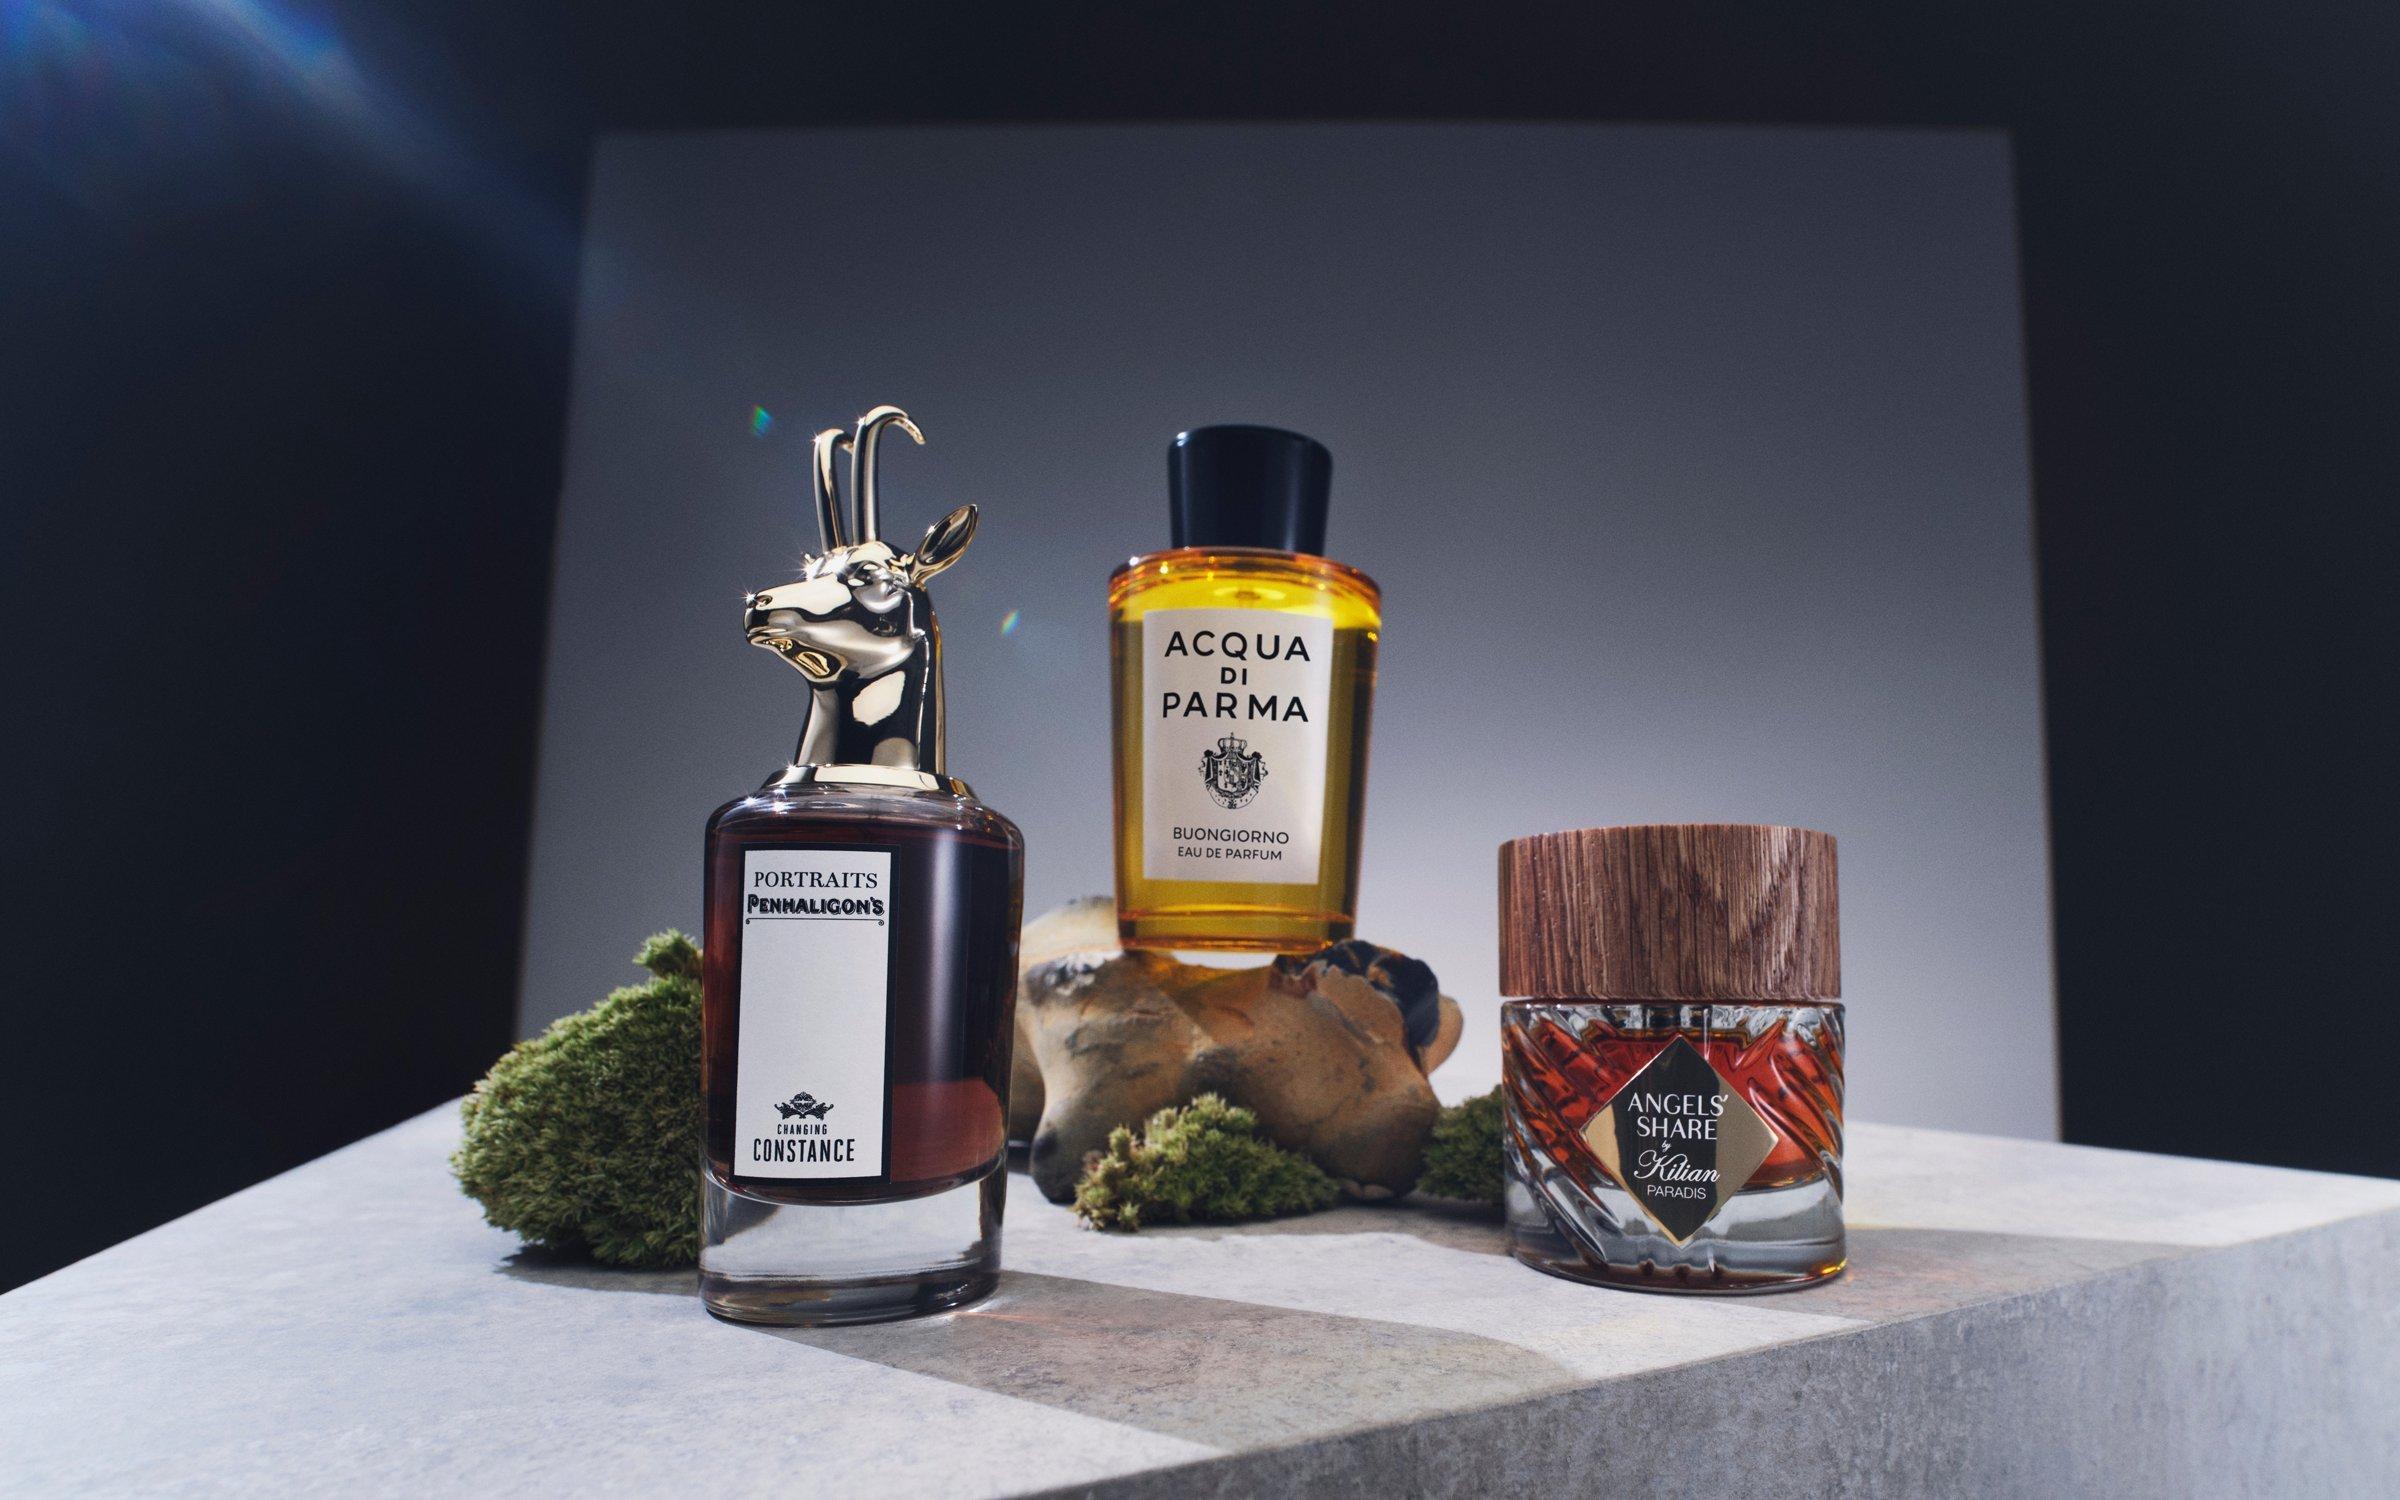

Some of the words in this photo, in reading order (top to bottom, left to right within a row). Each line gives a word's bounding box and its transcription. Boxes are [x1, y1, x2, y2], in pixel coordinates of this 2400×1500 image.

[1164, 630, 1310, 662] ACQUA
[1220, 666, 1248, 686] DI
[1162, 692, 1309, 722] PARMA
[1172, 826, 1290, 845] BUONGIORNO
[1177, 846, 1203, 858] EAU
[1205, 847, 1222, 859] DE
[1226, 848, 1282, 861] PARFUM
[754, 871, 878, 889] PORTRAITS
[747, 893, 885, 916] PENHALIGON'S
[1627, 1092, 1729, 1117] ANGELS'
[777, 1123, 828, 1136] CHANGING
[1636, 1116, 1718, 1140] SHARE
[753, 1138, 856, 1163] CONSTANCE
[1661, 1140, 1672, 1152] by
[1633, 1150, 1721, 1182] Kilian
[1647, 1185, 1707, 1200] PARADIS
